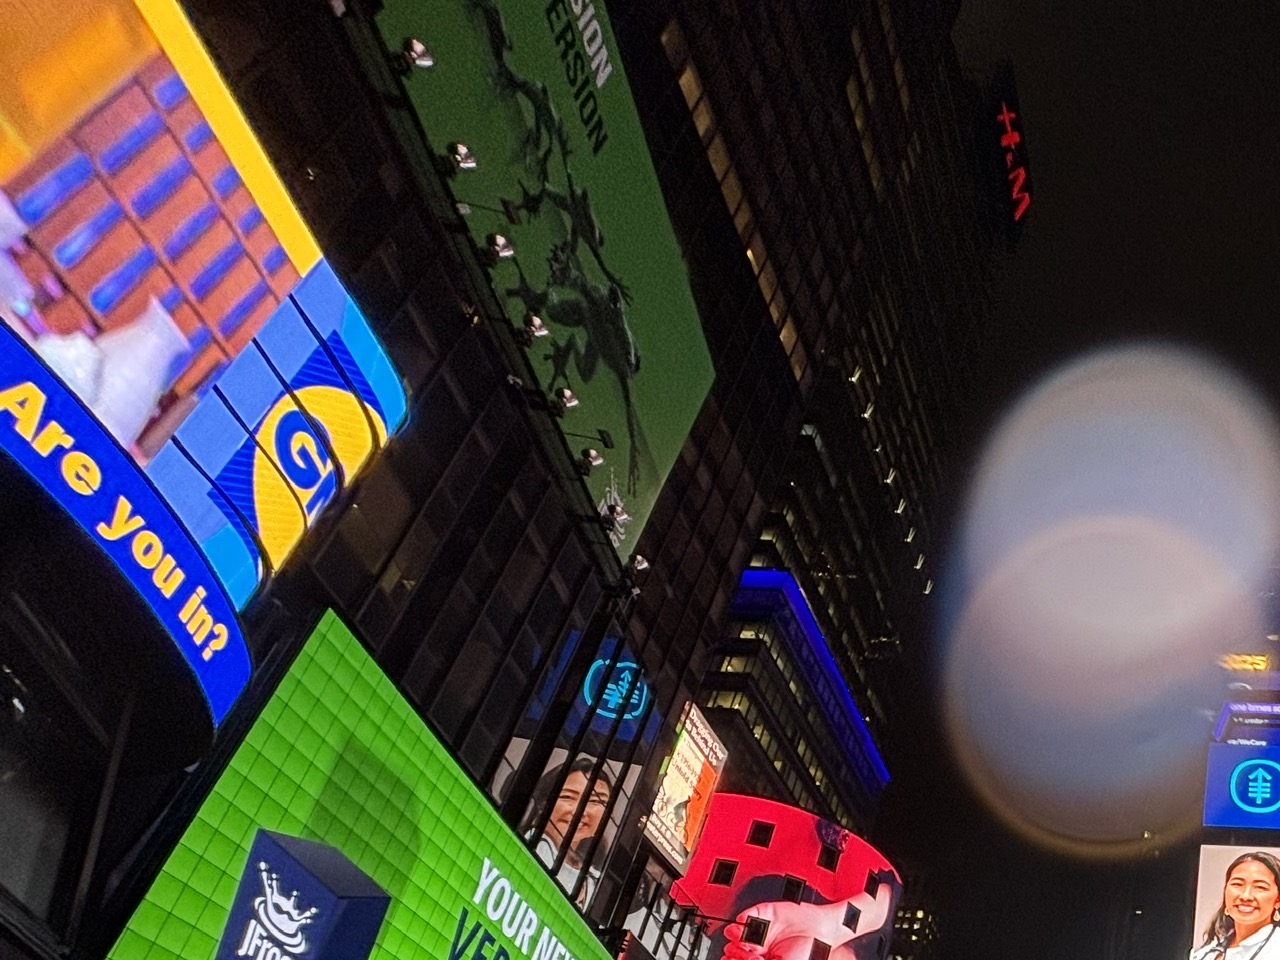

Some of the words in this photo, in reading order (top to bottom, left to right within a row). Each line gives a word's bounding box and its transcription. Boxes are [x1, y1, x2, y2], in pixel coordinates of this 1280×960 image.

[0, 381, 102, 497] Are
[96, 495, 187, 600] you
[178, 585, 229, 662] in?
[473, 856, 540, 955] YOUR
